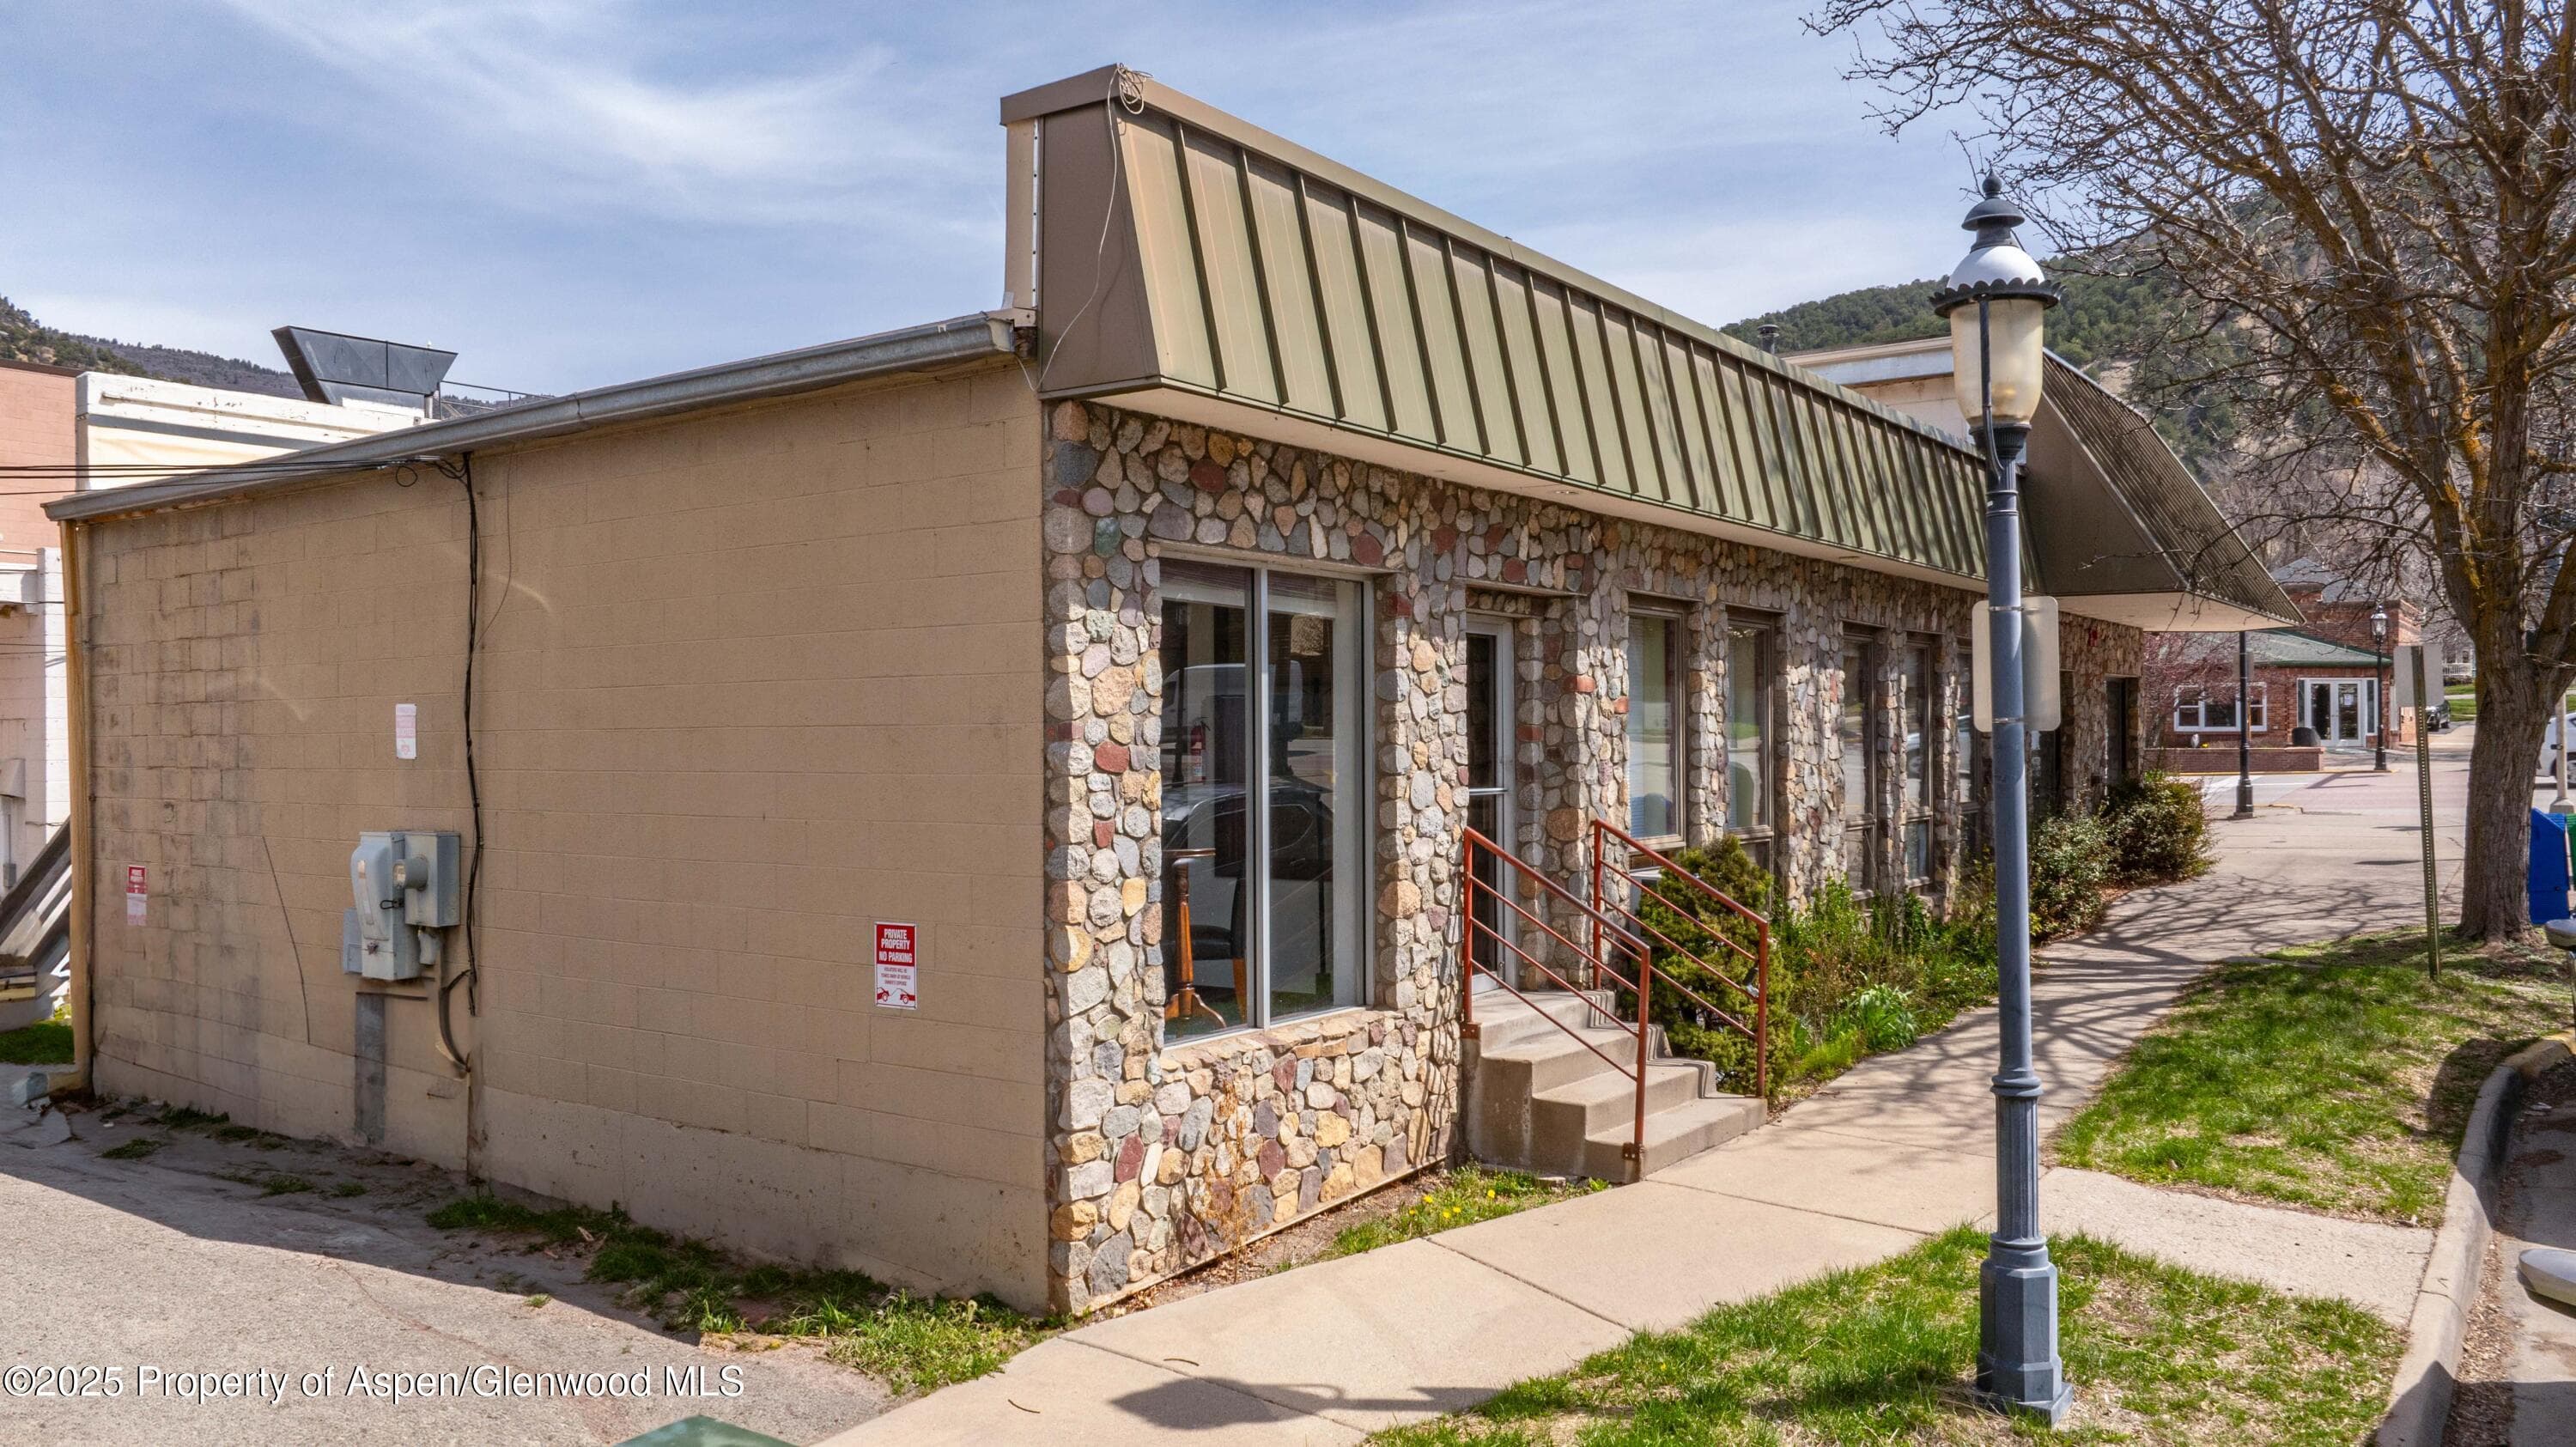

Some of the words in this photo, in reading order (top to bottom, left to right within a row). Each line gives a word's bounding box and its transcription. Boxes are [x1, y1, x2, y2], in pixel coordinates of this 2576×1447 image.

[884, 928, 907, 939] PRIVATE
[881, 938, 910, 950] PROPERTY
[878, 951, 887, 961] NO
[888, 951, 913, 963] PARKING
